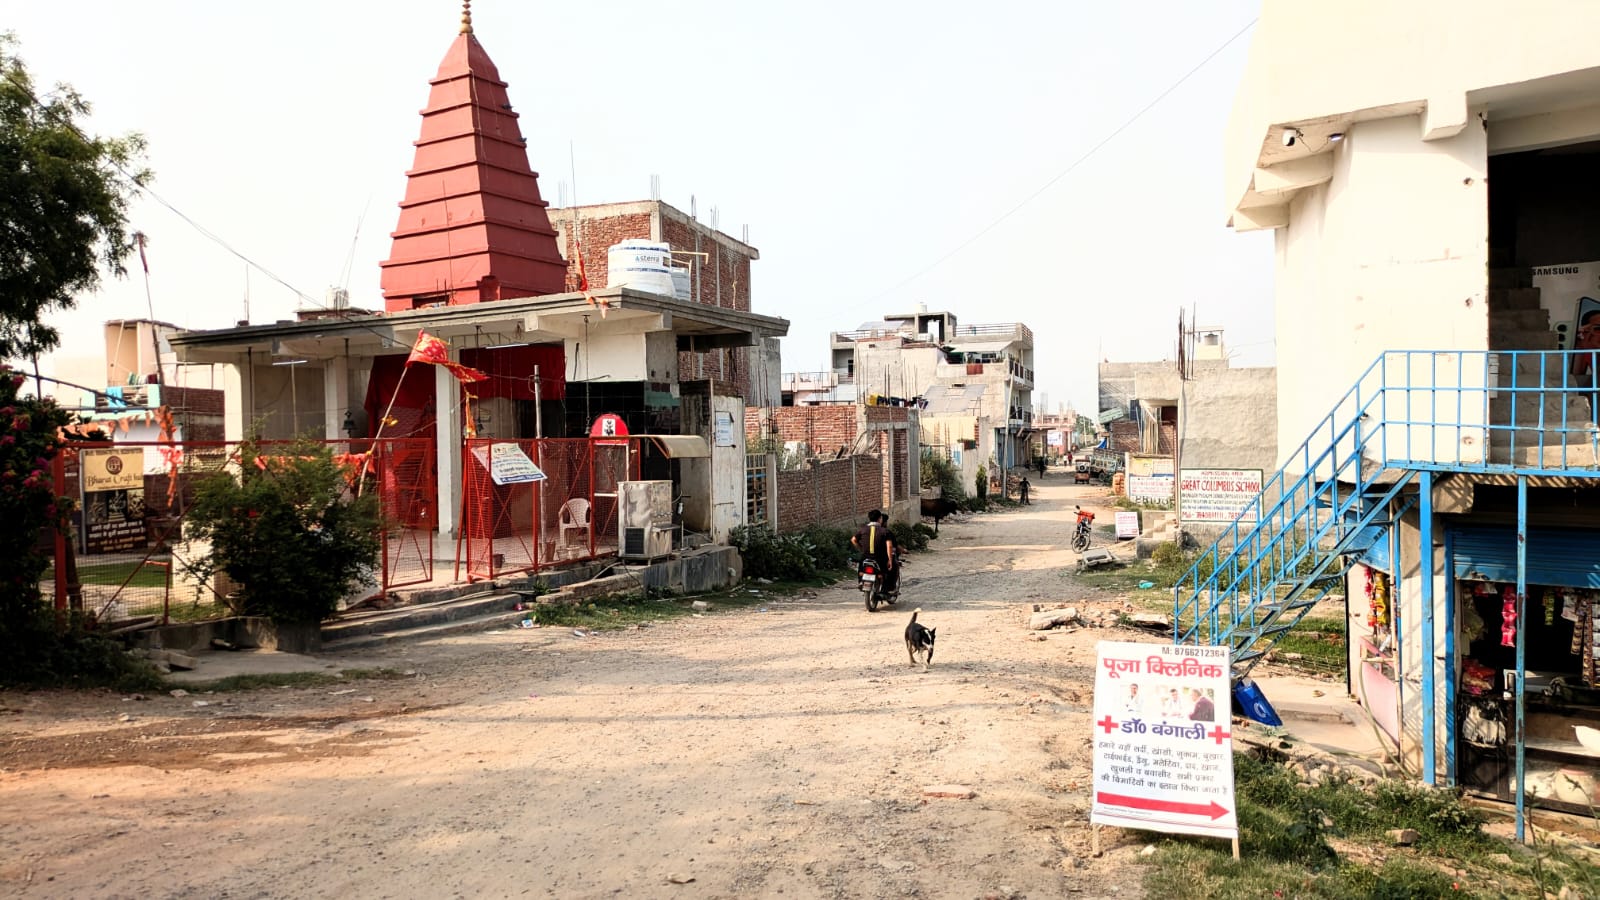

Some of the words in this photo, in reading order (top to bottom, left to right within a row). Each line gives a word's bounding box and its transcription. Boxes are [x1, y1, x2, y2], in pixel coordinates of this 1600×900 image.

[1181, 480, 1201, 491] GREAT
[1201, 480, 1235, 492] COLUMBUS
[1235, 481, 1260, 493] SCHOOL
[1103, 656, 1141, 679] पूजा
[1146, 655, 1224, 678] क्लिनिक
[1151, 720, 1207, 740] बंगाली
